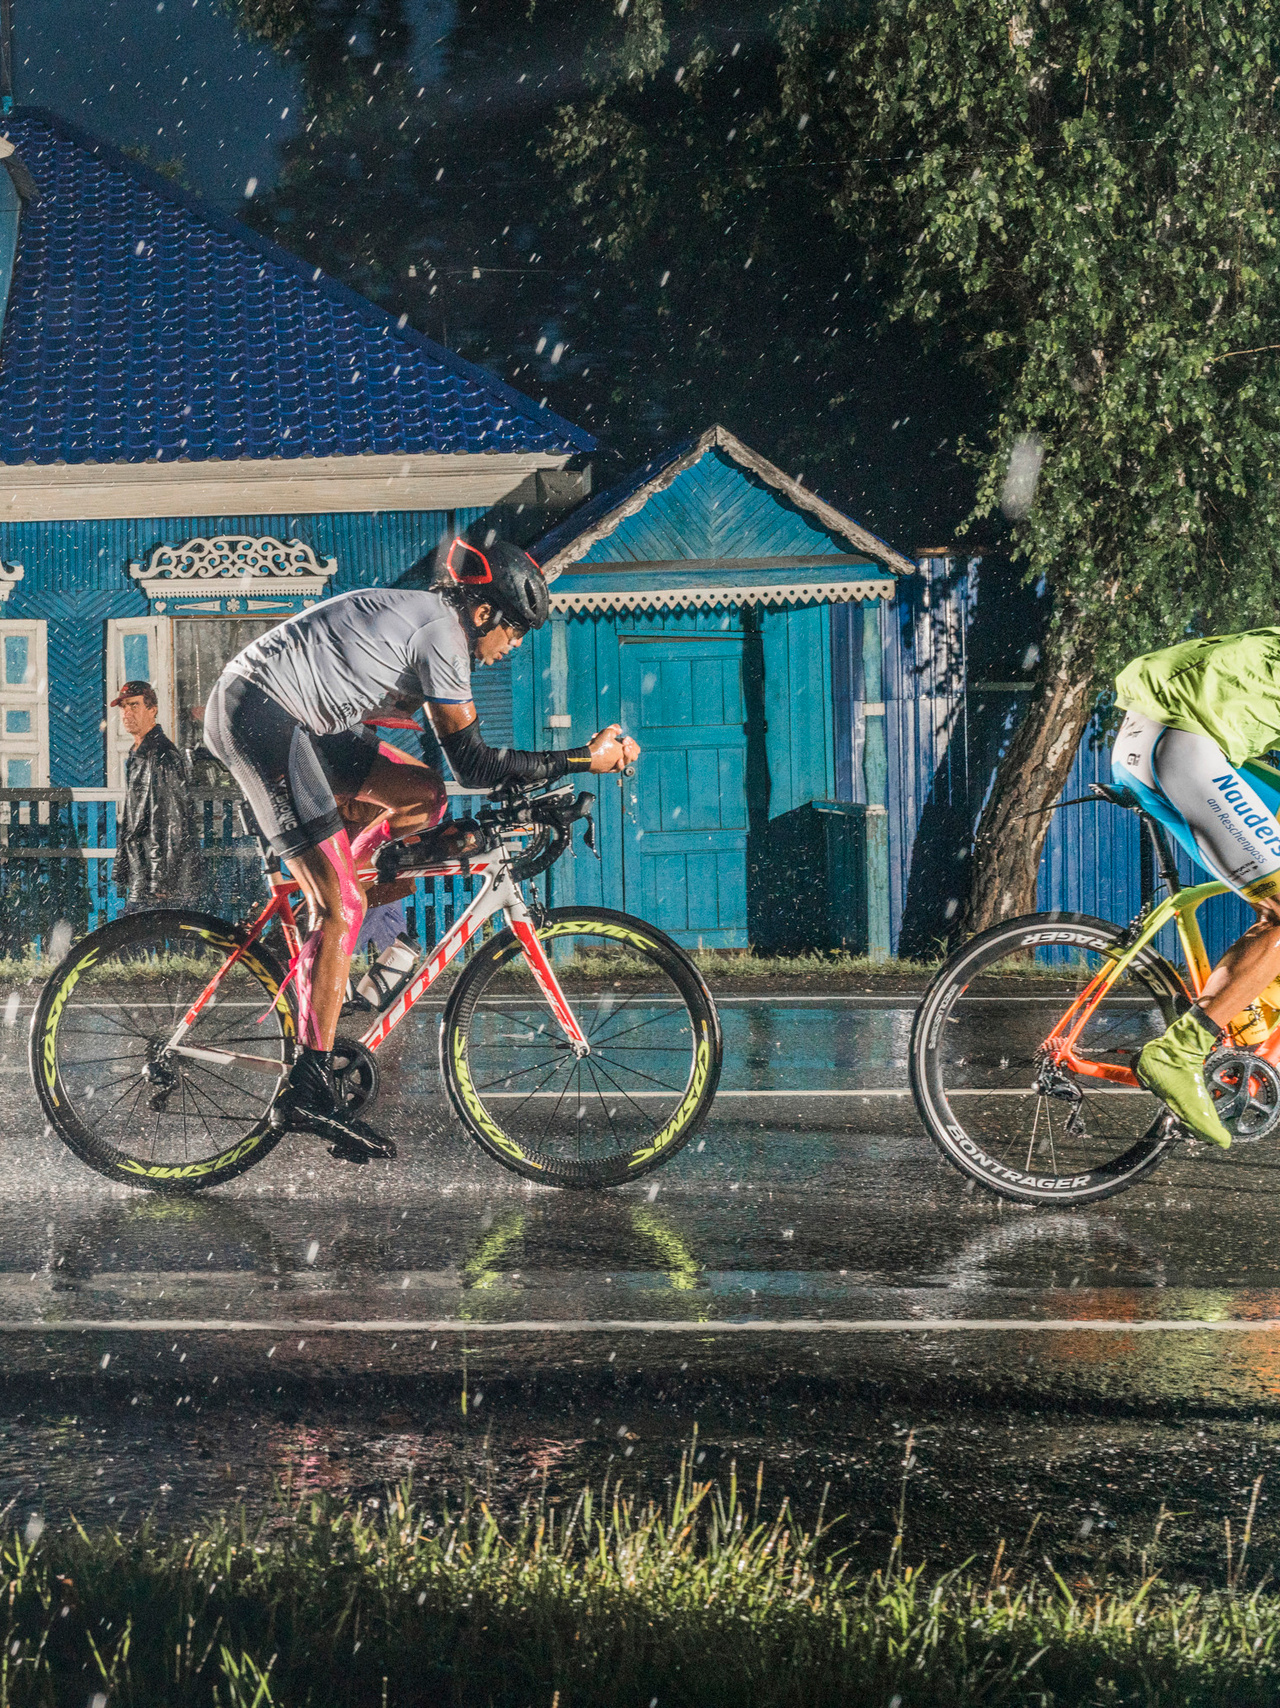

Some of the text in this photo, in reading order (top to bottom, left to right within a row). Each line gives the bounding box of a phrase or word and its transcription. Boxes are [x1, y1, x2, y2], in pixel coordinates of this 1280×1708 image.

[1206, 798, 1221, 813] am
[1217, 812, 1267, 864] Reschenpass
[1212, 773, 1280, 857] Nauders
[946, 1124, 1091, 1189] BONTRAGER
